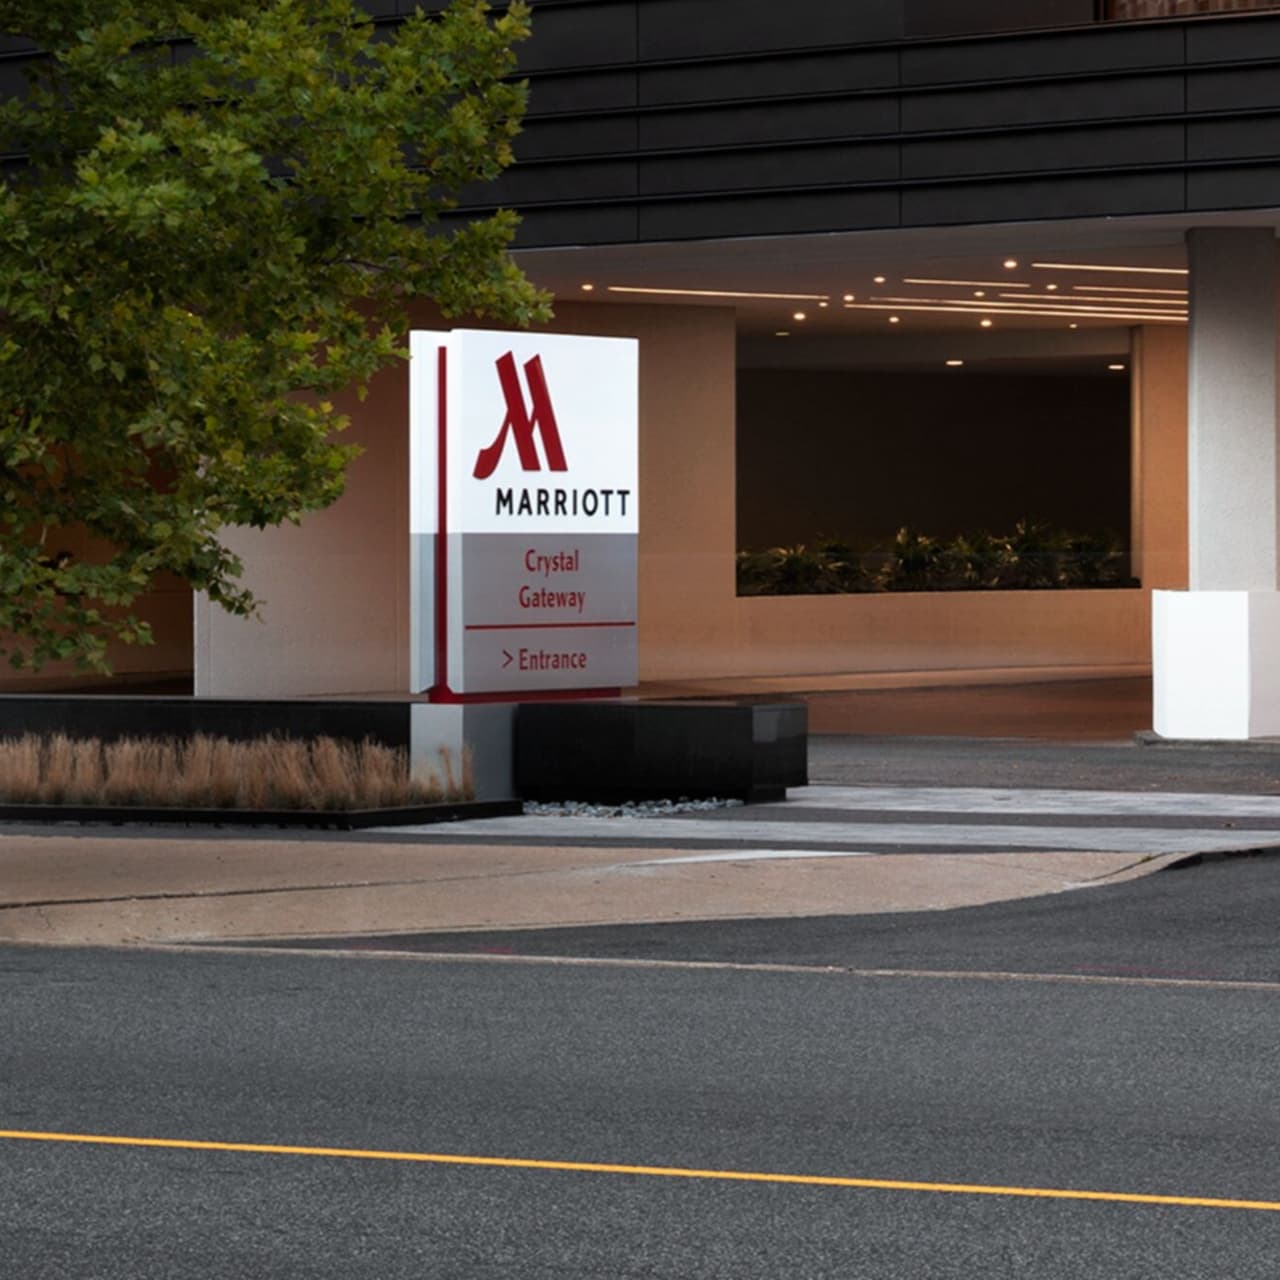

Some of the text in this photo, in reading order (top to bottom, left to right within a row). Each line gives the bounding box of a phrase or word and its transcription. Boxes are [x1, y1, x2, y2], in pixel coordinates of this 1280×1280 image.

[495, 488, 631, 516] MARRIOTT
[525, 549, 580, 578] Crystal
[518, 586, 586, 613] Gateway
[519, 648, 587, 670] Entrance
